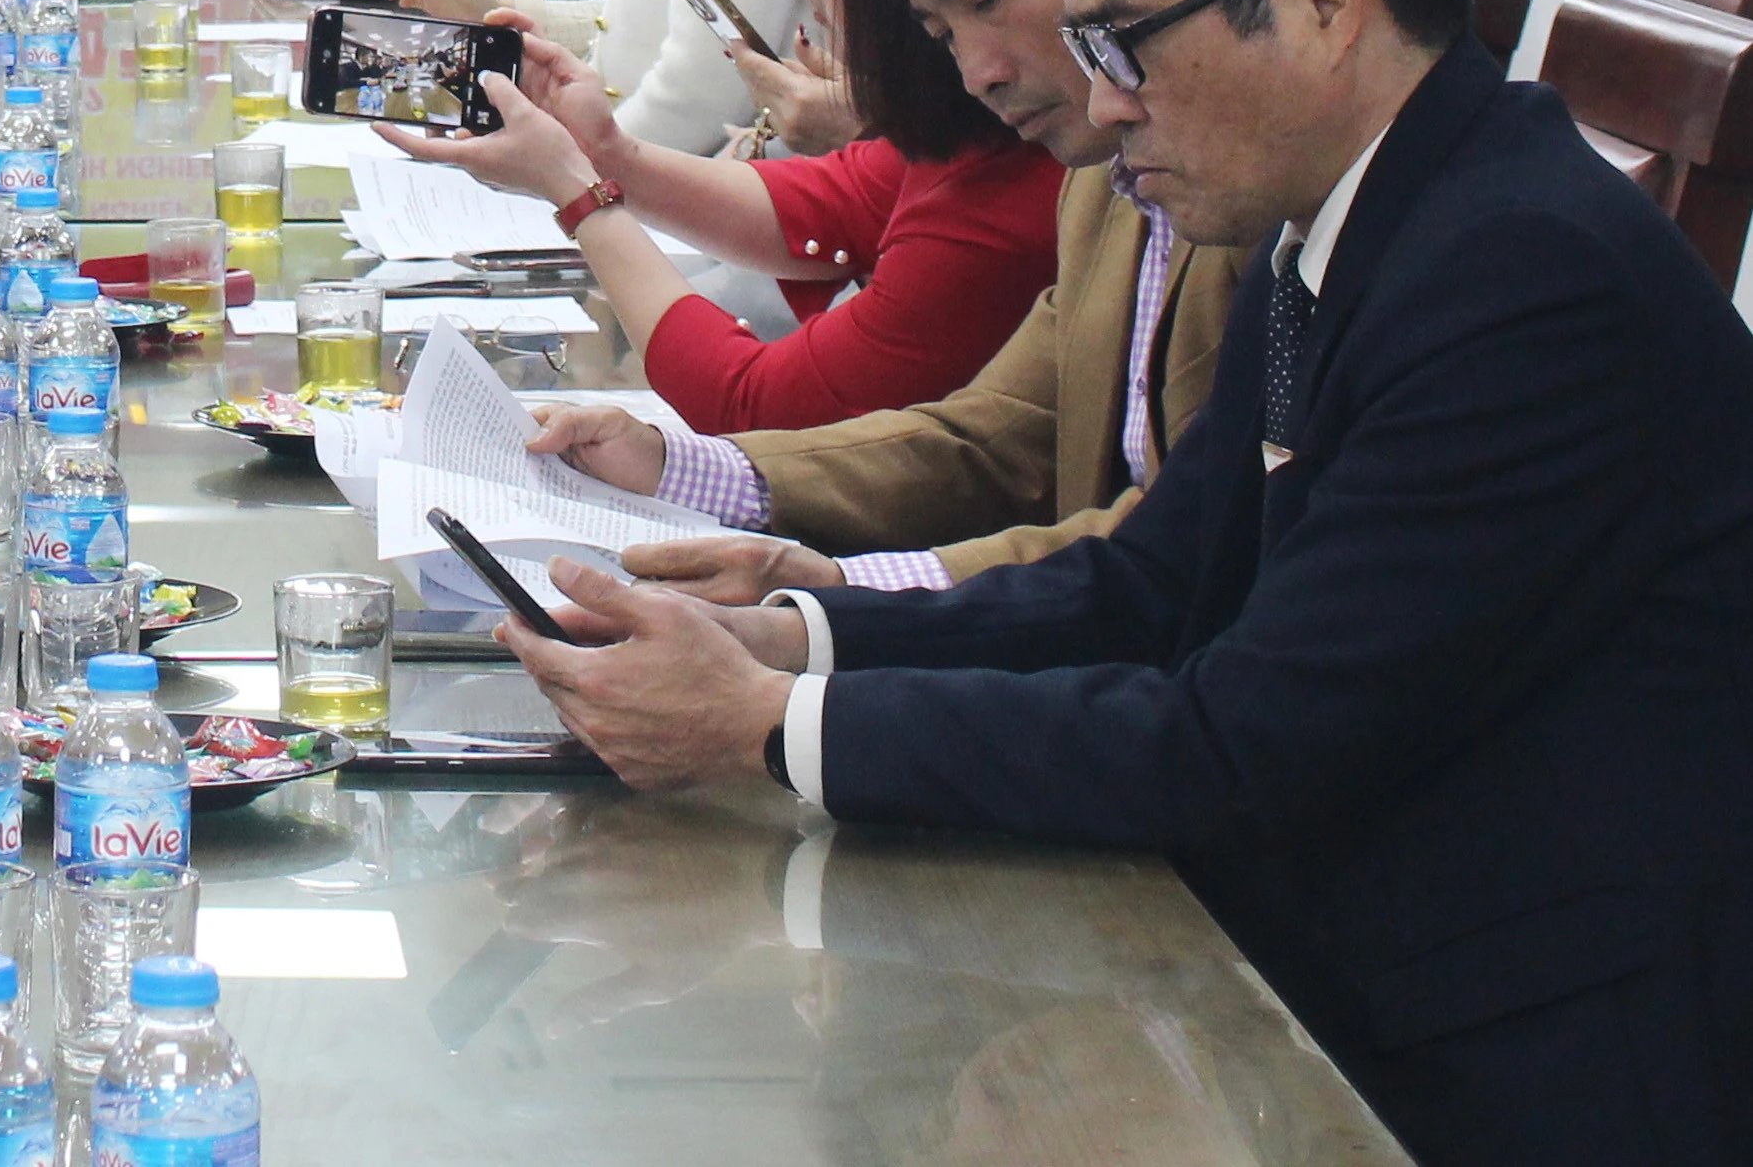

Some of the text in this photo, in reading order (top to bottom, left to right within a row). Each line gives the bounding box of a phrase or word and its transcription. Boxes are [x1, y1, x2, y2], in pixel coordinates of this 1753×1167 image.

[0, 169, 46, 188] laVie
[35, 386, 96, 410] laVie
[94, 820, 181, 857] laVie
